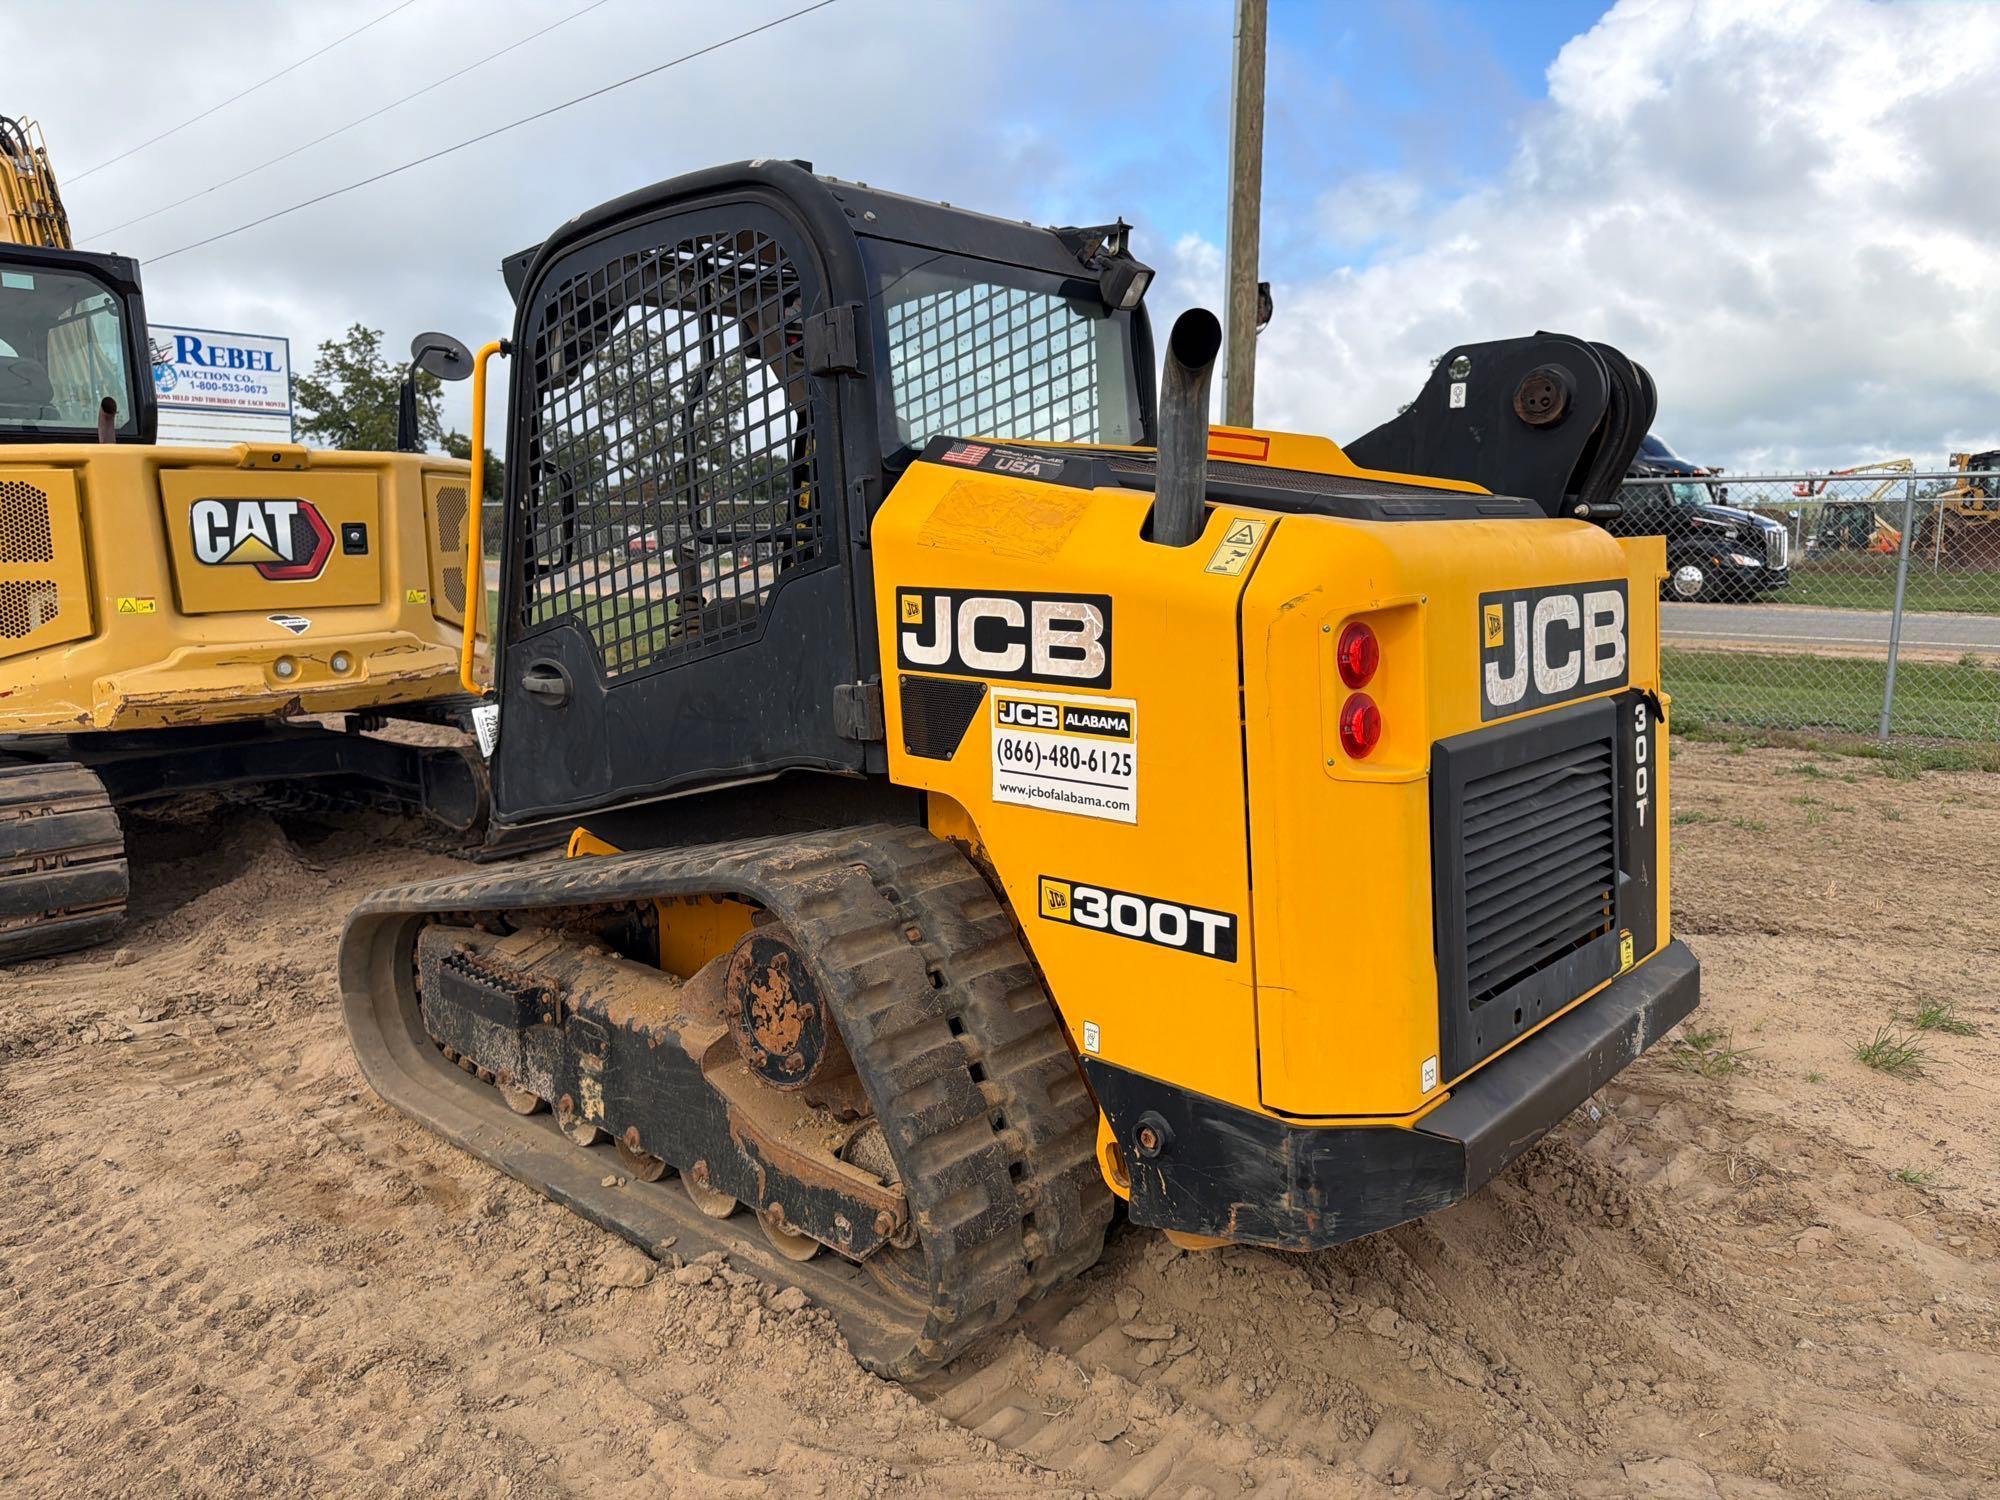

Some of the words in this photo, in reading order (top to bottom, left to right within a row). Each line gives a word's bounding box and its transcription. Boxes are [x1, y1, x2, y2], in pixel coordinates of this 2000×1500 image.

[173, 335, 282, 372] REBEL
[178, 369, 231, 381] AUCTION
[234, 374, 254, 384] CO.
[190, 380, 268, 394] 1-800-533-0673
[994, 458, 1040, 475] USA
[192, 500, 298, 563] CAT
[902, 595, 1106, 679] JCB
[1485, 590, 1626, 706] JCB
[1000, 702, 1058, 728] JCB
[1065, 713, 1129, 732] ALABAMA
[997, 738, 1132, 776] (866)-480-6125
[1634, 703, 1648, 827] 300T
[1000, 783, 1130, 811] www.jcbofalabama.com
[1073, 886, 1230, 955] 300T
